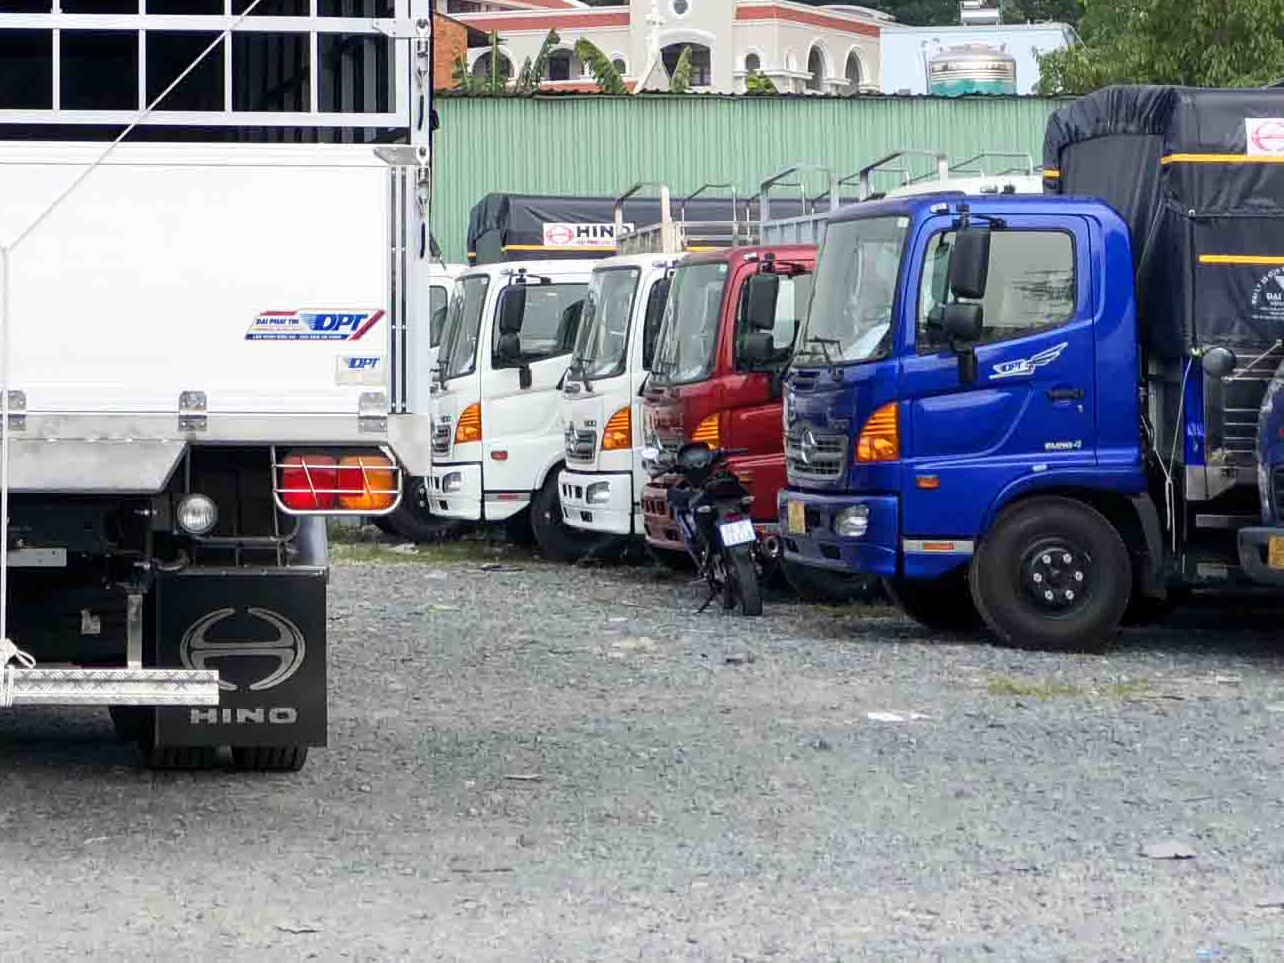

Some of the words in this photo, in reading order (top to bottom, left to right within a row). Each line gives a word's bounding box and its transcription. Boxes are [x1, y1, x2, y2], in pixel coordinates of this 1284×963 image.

[313, 313, 369, 332] DPT
[348, 357, 380, 369] DPT
[191, 708, 297, 724] HINO
